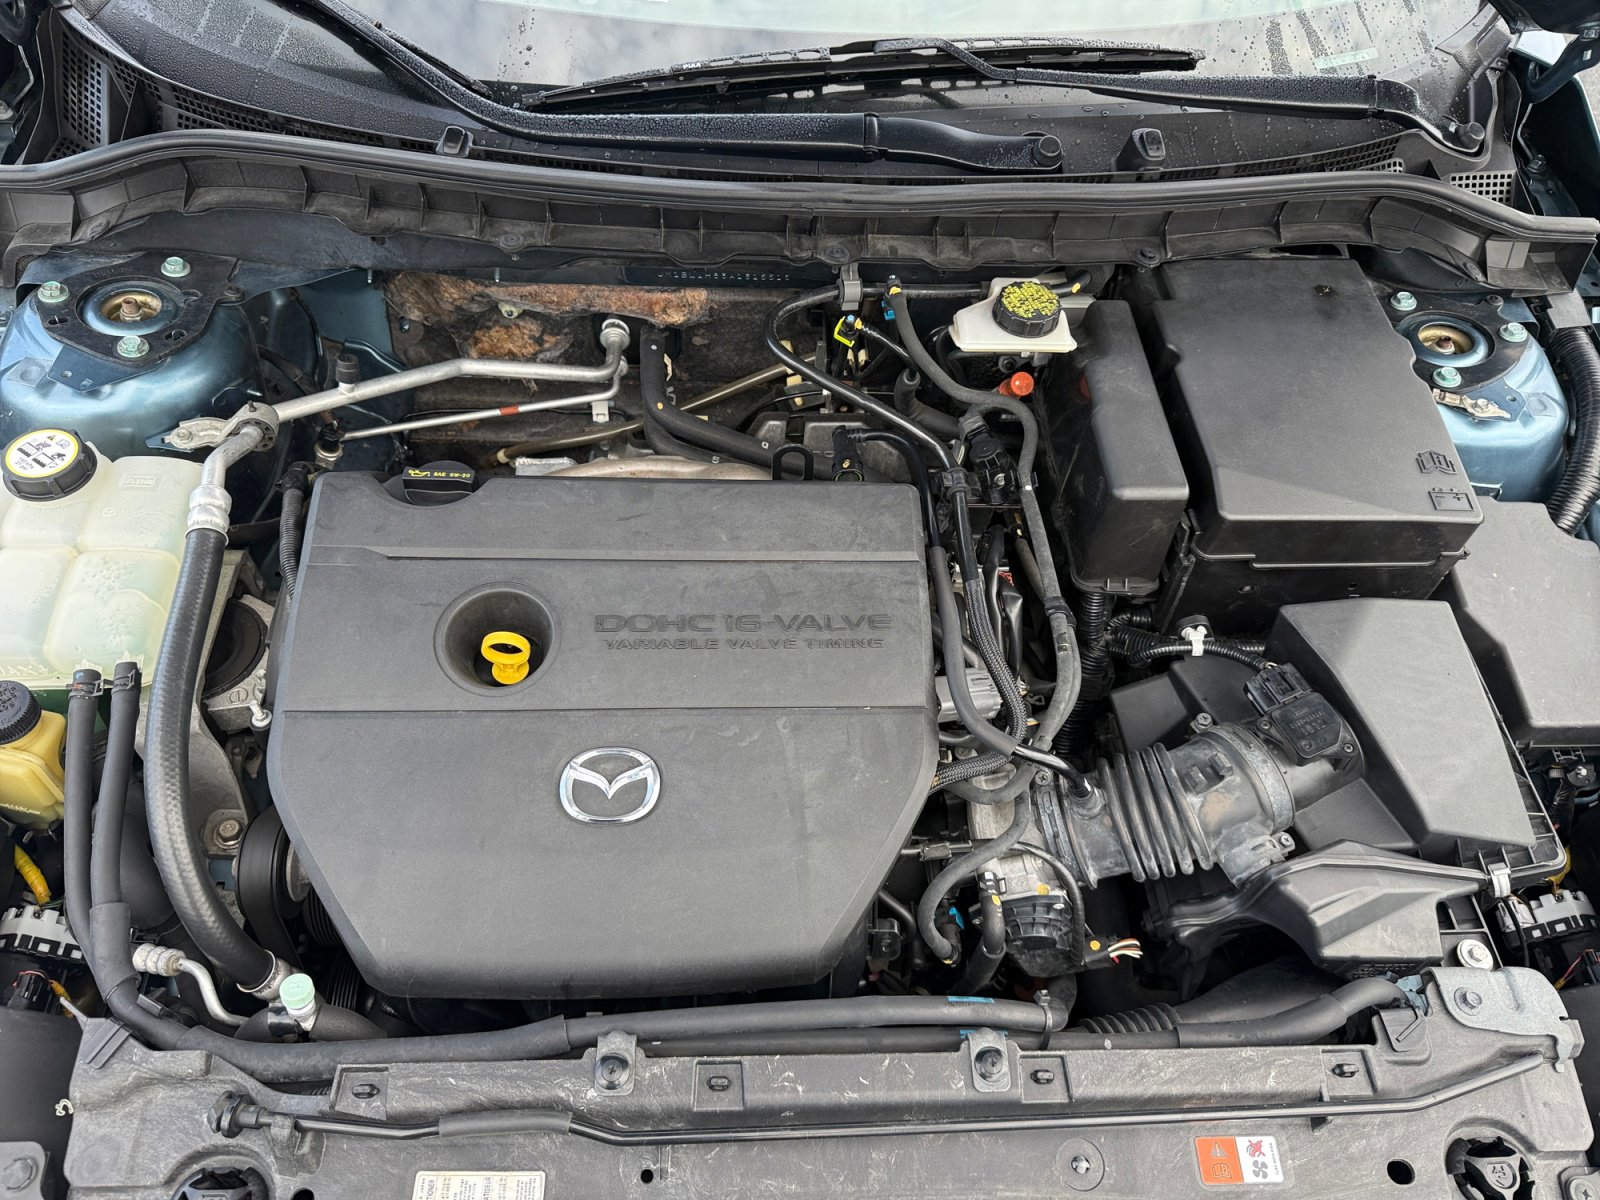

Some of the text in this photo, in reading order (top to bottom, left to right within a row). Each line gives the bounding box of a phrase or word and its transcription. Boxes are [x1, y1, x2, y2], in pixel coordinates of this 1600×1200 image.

[593, 613, 896, 633] DOHC 16-VALVE
[602, 638, 885, 650] VARIABLE VALVE TIMING
